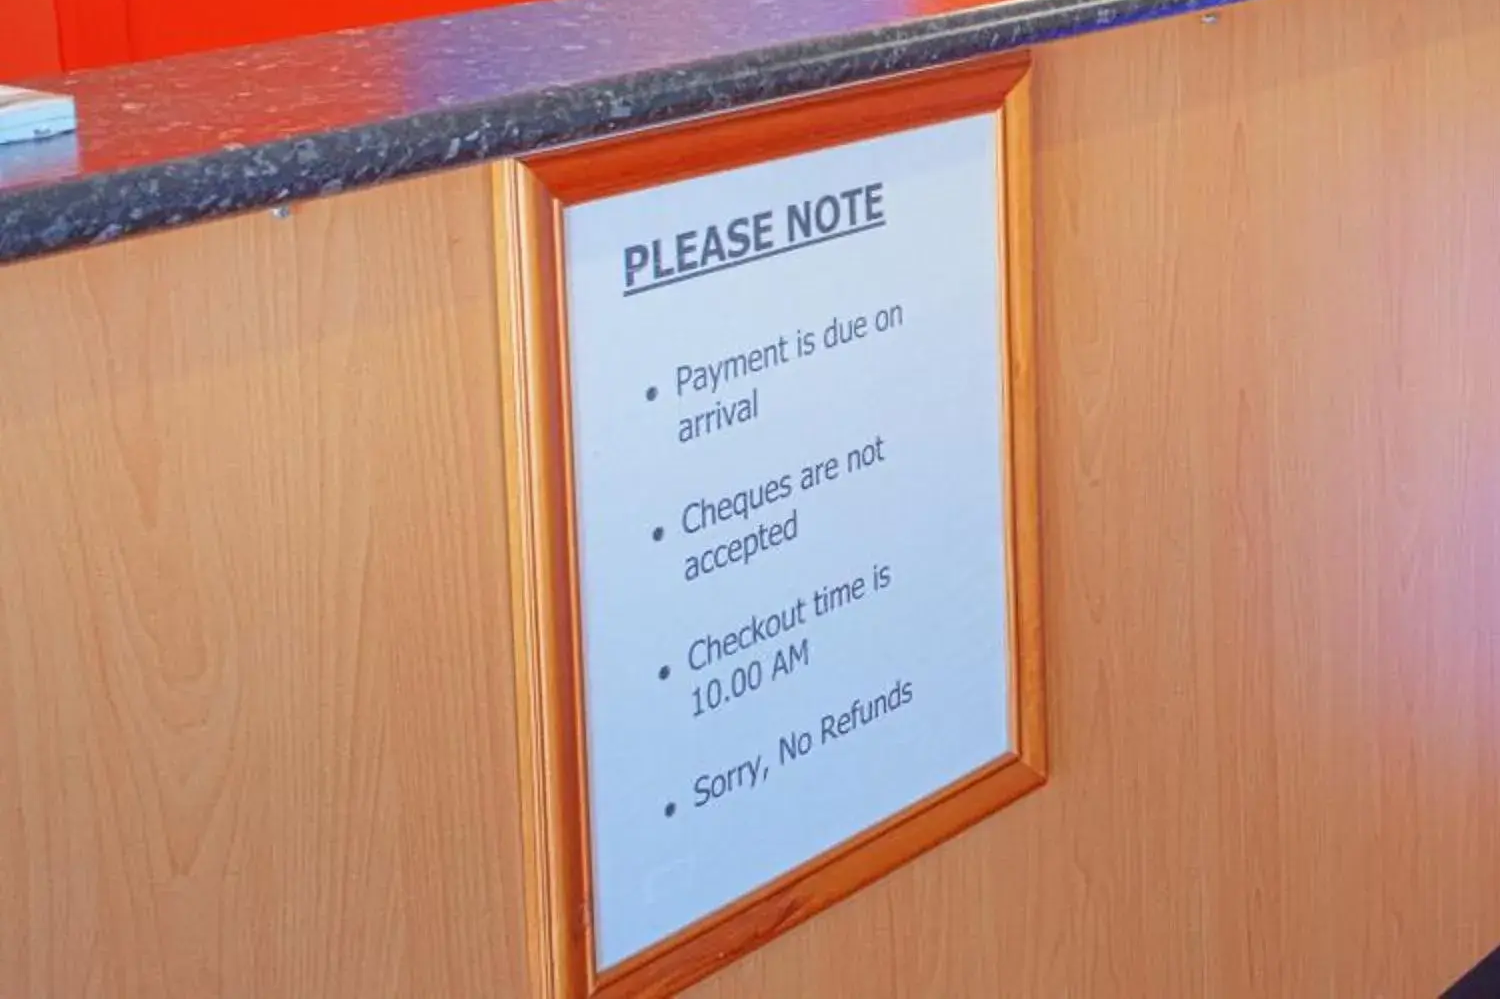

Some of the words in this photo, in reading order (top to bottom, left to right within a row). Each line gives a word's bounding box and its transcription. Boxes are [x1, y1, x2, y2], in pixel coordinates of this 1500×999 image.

[623, 211, 773, 288] PLEASE
[786, 182, 884, 243] NOTE
[675, 336, 790, 397] Payment
[796, 329, 816, 359] is
[823, 313, 868, 349] due
[874, 303, 904, 333] on
[678, 389, 759, 443] arrival
[681, 474, 793, 535] Cheques
[800, 456, 839, 490] are
[847, 435, 886, 473] not
[684, 509, 799, 582] accepted
[687, 598, 807, 672] Checkout
[813, 577, 866, 618] time
[873, 563, 892, 591] is
[691, 660, 763, 718] 10.00
[771, 638, 811, 680] AM
[693, 754, 770, 808] Sorry,
[779, 732, 813, 766] No
[820, 679, 914, 745] Refunds
